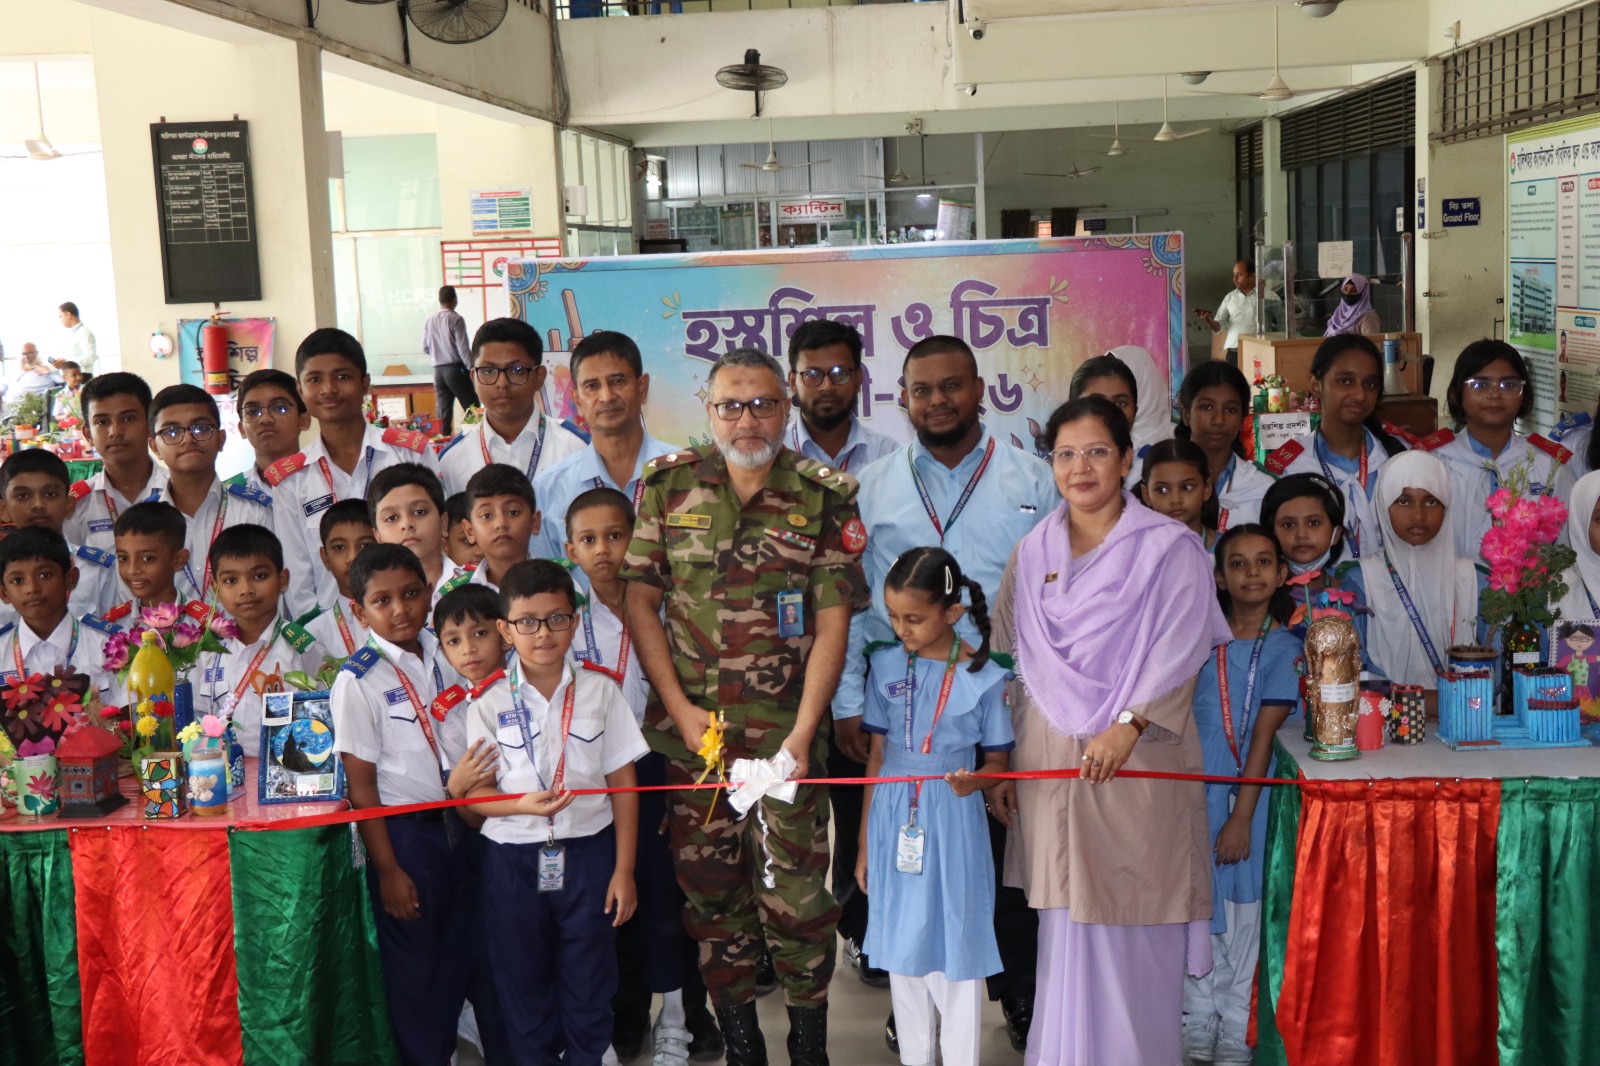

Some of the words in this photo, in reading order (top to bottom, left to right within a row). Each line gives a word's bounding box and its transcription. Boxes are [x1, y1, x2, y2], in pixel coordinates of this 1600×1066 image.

[780, 200, 843, 215] ক্যান্টিন
[1443, 213, 1463, 223] Ground
[1464, 212, 1480, 221] Floor
[891, 302, 934, 350] ও
[950, 279, 1052, 349] চিত্র
[1279, 448, 1294, 460] VII
[281, 459, 297, 473] VII
[361, 651, 371, 661] II
[345, 659, 368, 673] HCPSC
